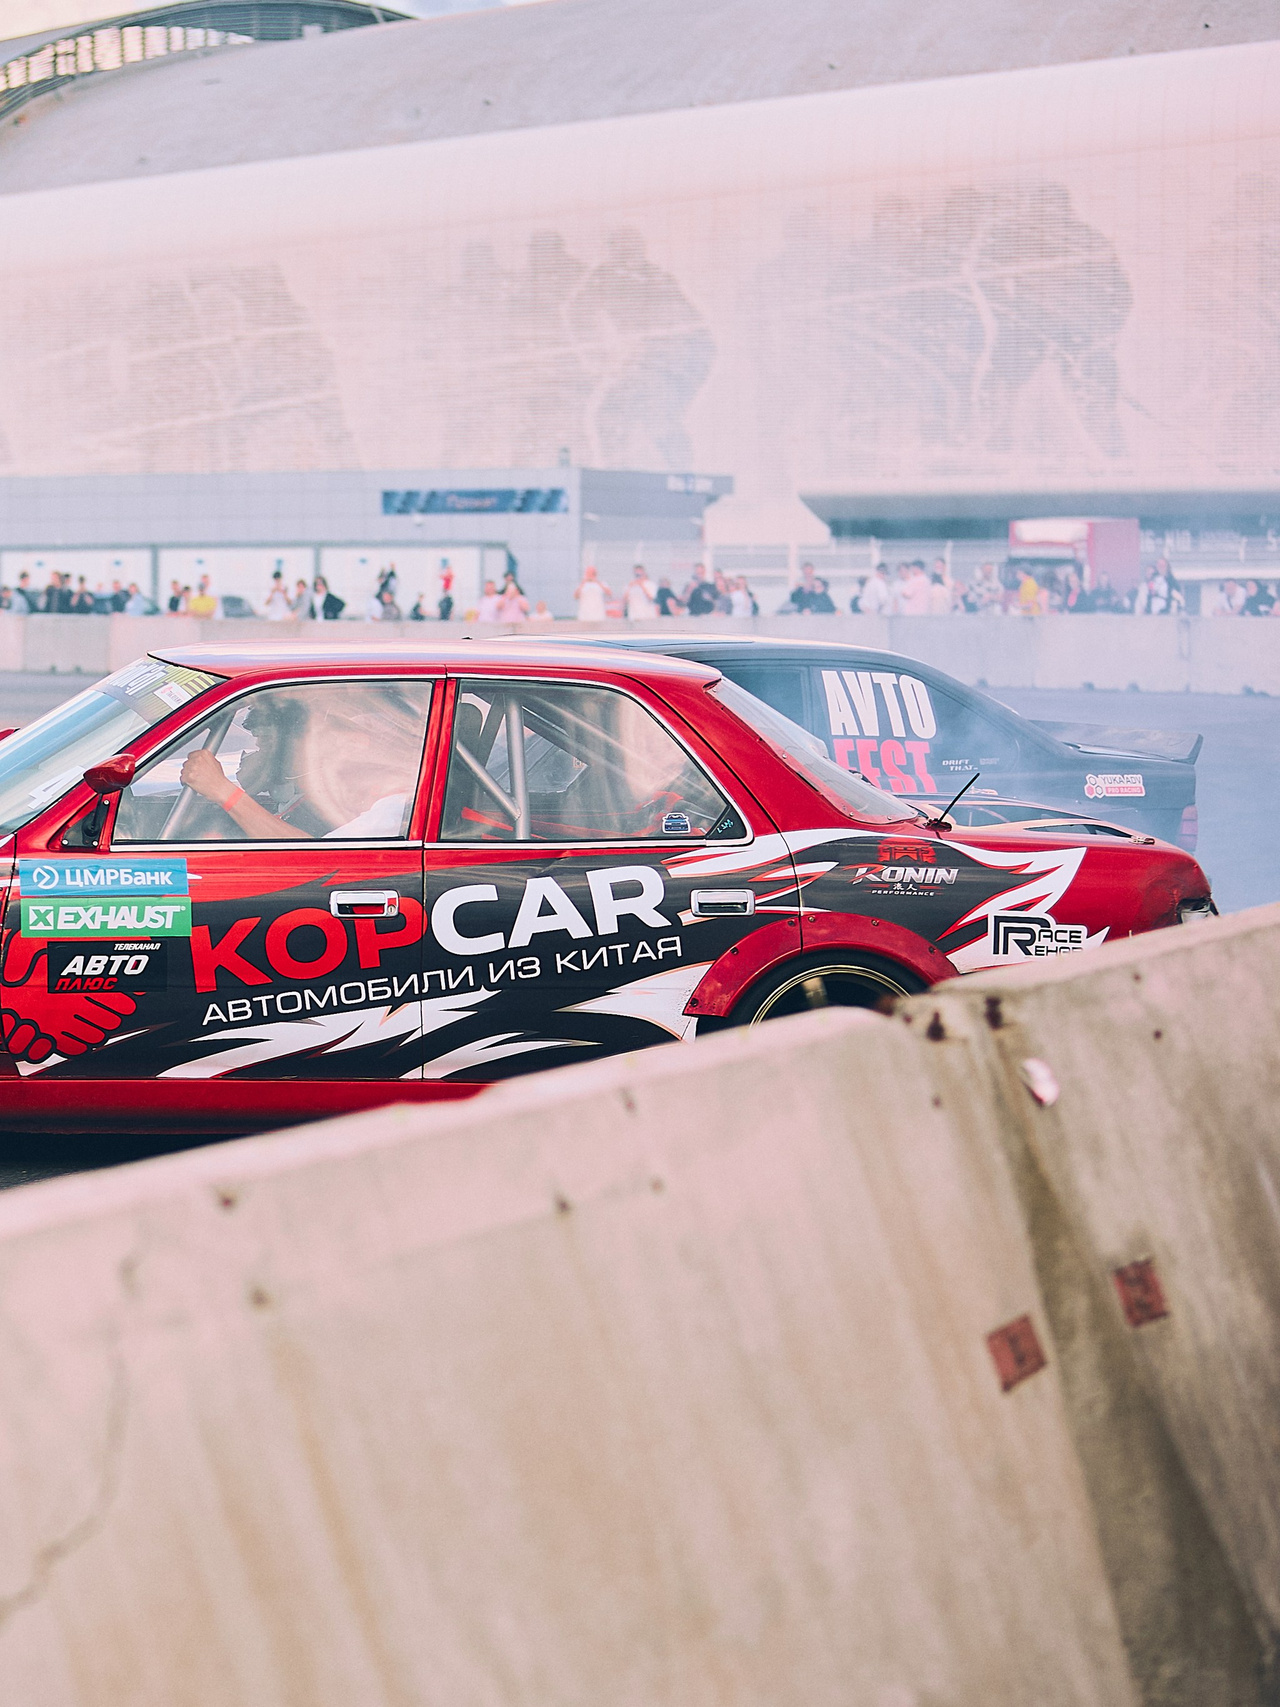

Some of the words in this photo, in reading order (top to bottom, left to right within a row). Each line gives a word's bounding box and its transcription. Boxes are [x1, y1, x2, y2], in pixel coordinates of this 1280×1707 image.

[821, 670, 937, 739] AVTO
[65, 868, 174, 887] ЦМРБанк
[841, 862, 960, 885] RONIN
[113, 943, 162, 951] ТЕЛЕКАНАЛ
[60, 954, 150, 976] АВТО
[54, 978, 118, 991] ПЛЮС
[201, 965, 473, 1026] АВТОМОБИЛИ
[489, 955, 542, 984] ИЗ
[556, 936, 683, 975] КИТАЯ
